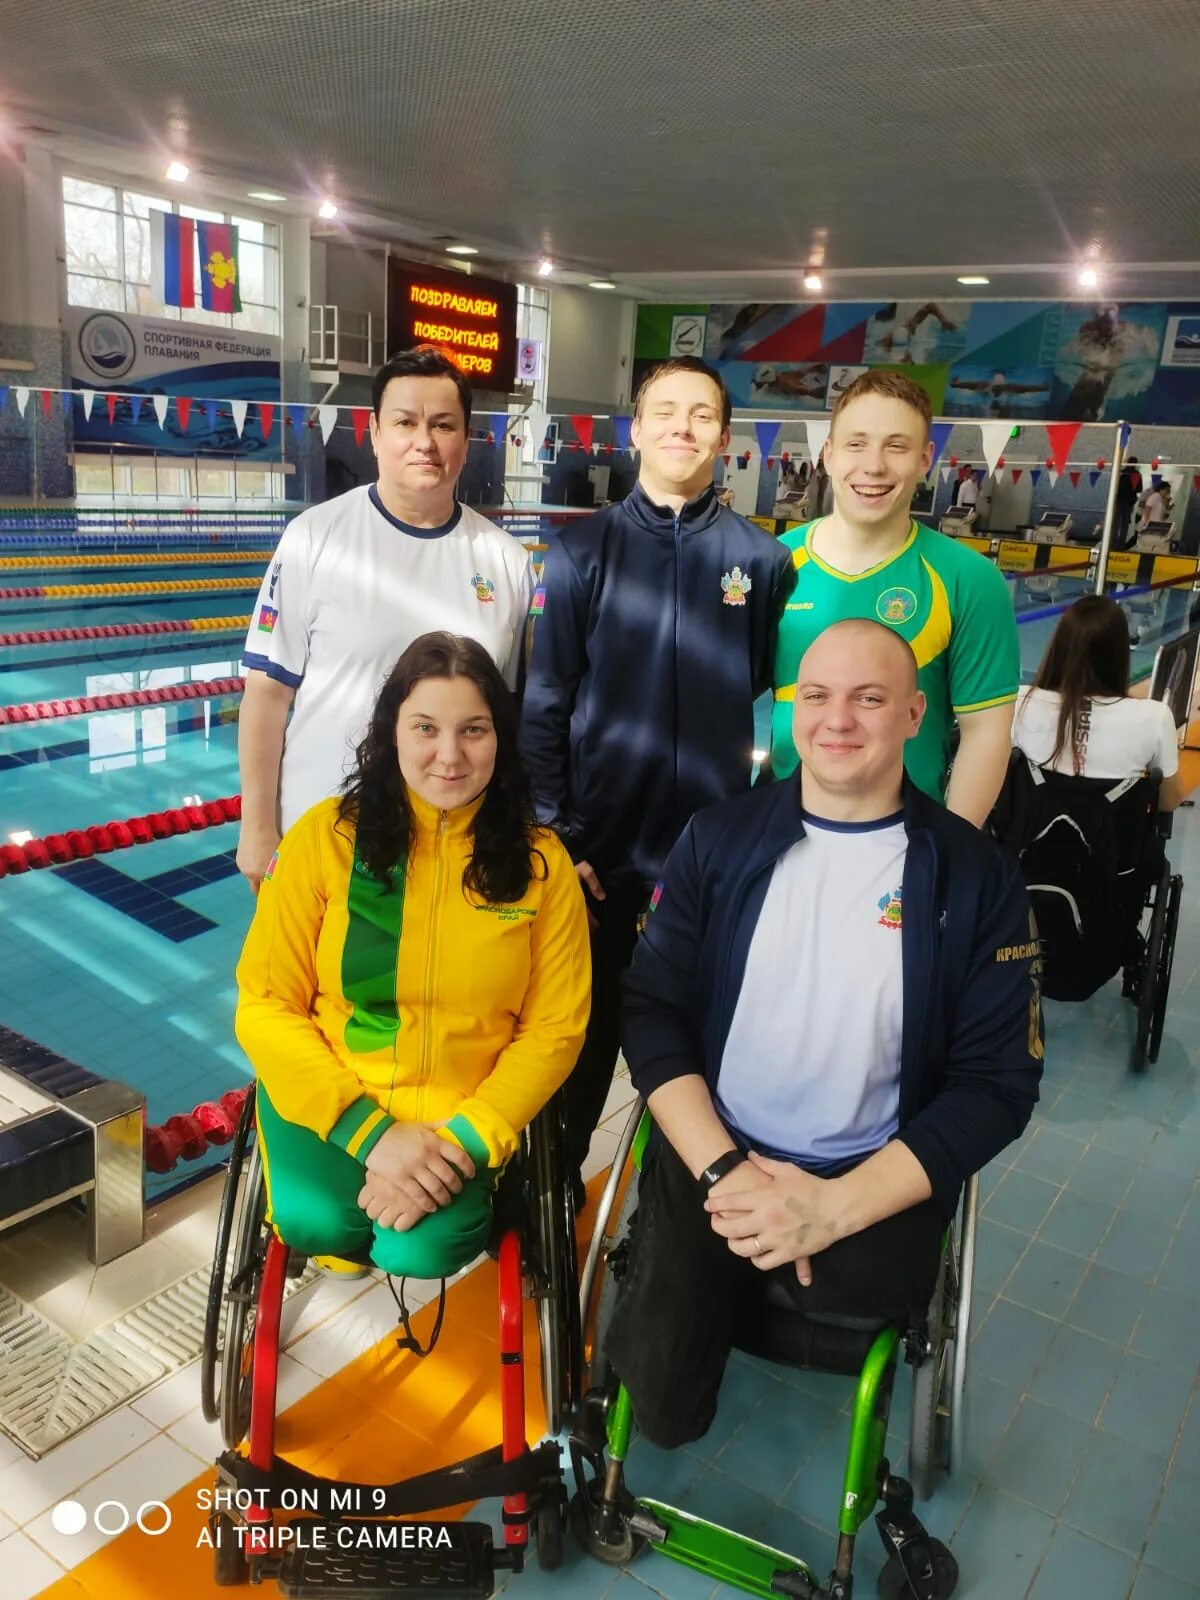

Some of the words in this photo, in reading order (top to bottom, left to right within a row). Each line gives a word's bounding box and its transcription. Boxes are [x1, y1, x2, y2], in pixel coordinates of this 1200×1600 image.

[410, 285, 497, 318] ПОЗДРАВЛЯЕМ
[143, 331, 213, 350] СПОРТИВНАЯ
[214, 342, 272, 358] ФЕДЕРАЦИЯ
[414, 321, 499, 351] ПОБЕДИТЕЛЕЙ
[144, 345, 201, 361] ПЛАВАНИЯ
[1002, 544, 1029, 553] OMEGA
[1107, 555, 1131, 564] MEGA
